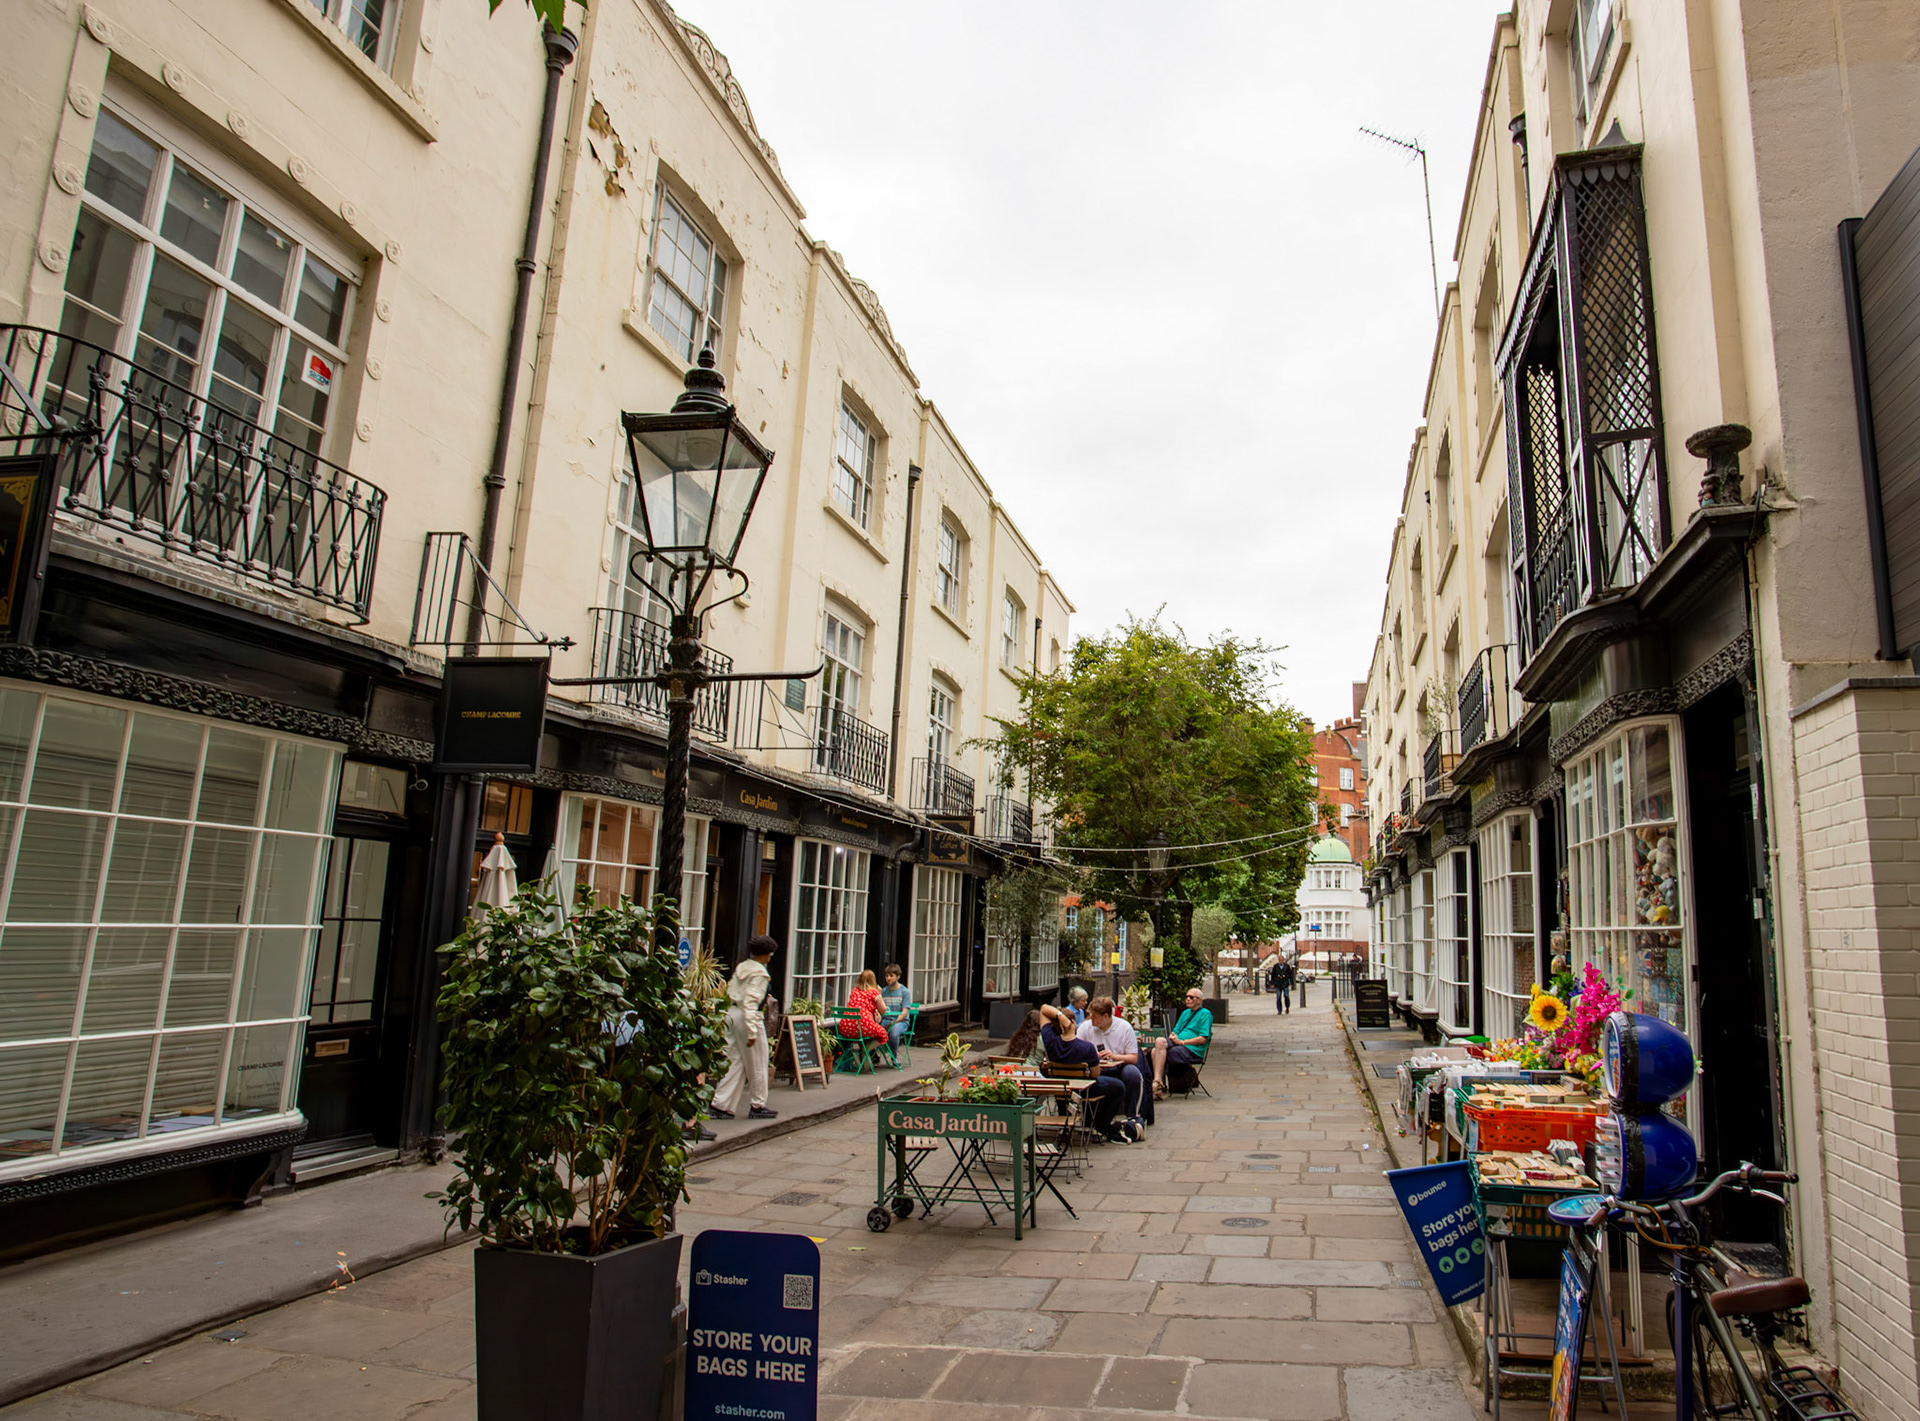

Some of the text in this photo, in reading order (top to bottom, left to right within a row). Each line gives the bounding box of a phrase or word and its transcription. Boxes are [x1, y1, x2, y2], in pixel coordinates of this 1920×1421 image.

[740, 789, 778, 811] Casa Jardim
[888, 1110, 1008, 1135] Casa Jardim
[1417, 1181, 1447, 1201] bounce
[1422, 1213, 1455, 1237] Store
[1428, 1218, 1478, 1252] bags her
[713, 1273, 748, 1286] Stasher
[692, 1328, 812, 1356] STORE YOUR
[697, 1355, 806, 1383] BAGS HERE
[714, 1403, 785, 1421] stasher.com
